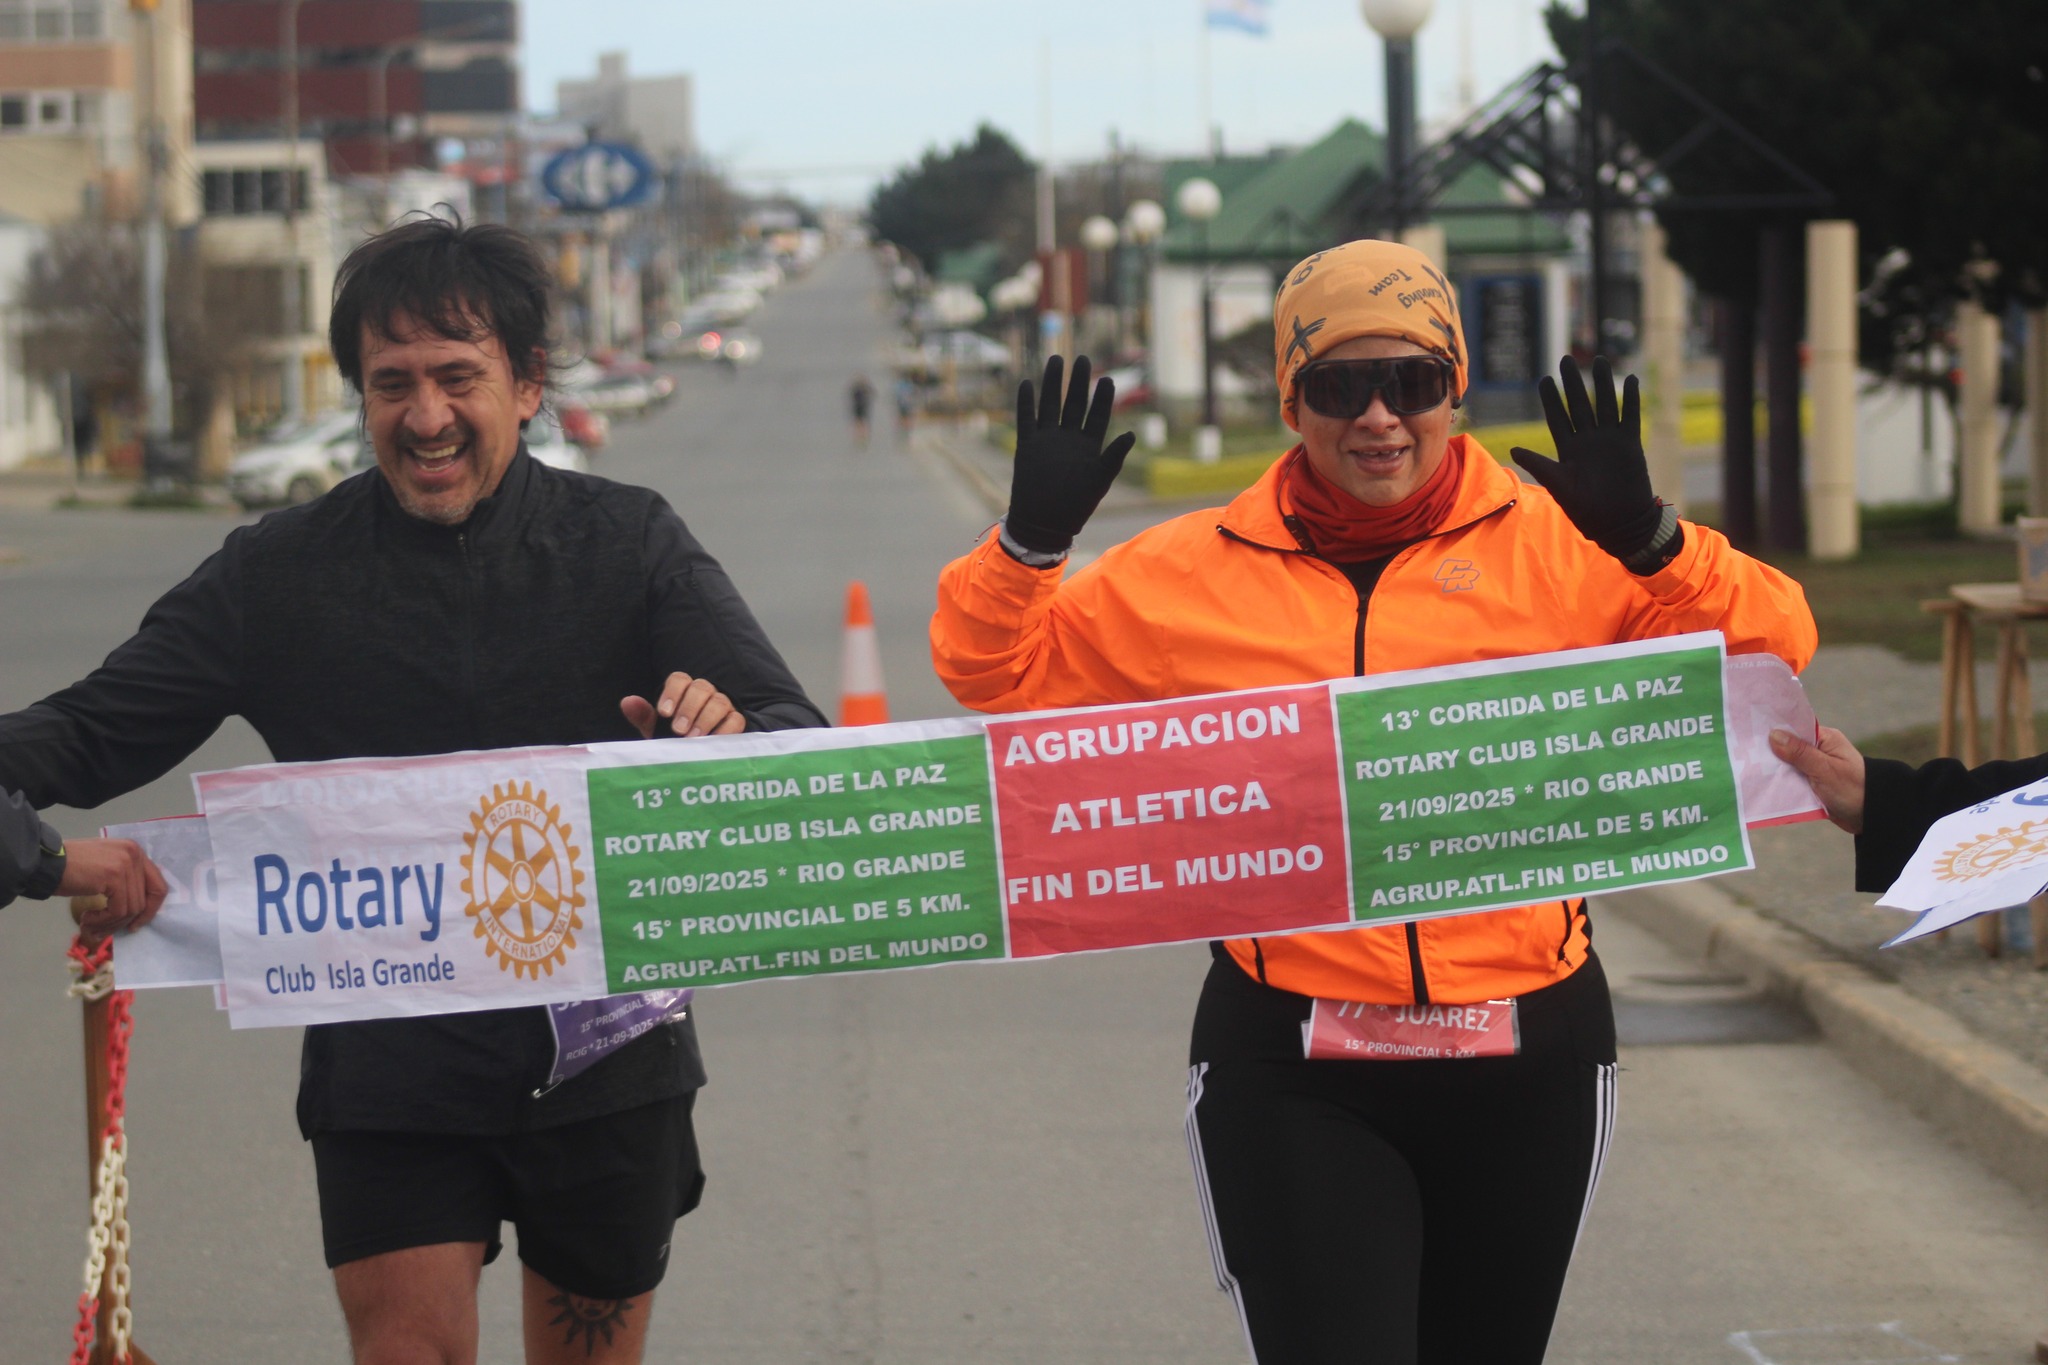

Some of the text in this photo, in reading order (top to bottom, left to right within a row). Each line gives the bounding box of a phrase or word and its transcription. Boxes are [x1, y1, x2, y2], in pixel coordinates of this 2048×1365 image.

[1368, 268, 1414, 297] Team
[1381, 675, 1683, 732] 13° CORRIDA DE LA PAZ
[1004, 703, 1300, 767] AGRUPACION
[1356, 714, 1714, 781] ROTARY CLUB ISLA GRANDE
[632, 763, 947, 810] 13° CORRIDA DE LA PAZ
[1051, 781, 1271, 834] ATLETICA
[1379, 786, 1516, 822] 21/09/2025
[1544, 777, 1590, 801] RIO
[1597, 760, 1704, 793] GRANDE
[489, 802, 541, 828] ROTARY
[604, 804, 982, 856] ROTARY CLUB ISLA GRANDE
[1382, 805, 1709, 864] 15° PROVINCIAL DE 5 KM.
[253, 853, 445, 942] Rotary
[628, 868, 769, 899] 21/09/2025
[798, 862, 845, 884] RIO
[853, 850, 966, 879] GRANDE
[1008, 844, 1324, 905] FIN DEL MUNDO
[1370, 845, 1729, 908] AGRUP.ATL.FIN DEL MUNDO
[484, 909, 571, 960] INTERNATIONAL
[632, 893, 971, 941] 15° PROVINCIAL DE 5 KM.
[266, 953, 456, 995] Club Isla Grande
[623, 933, 988, 984] AGRUP.ATL.FIN DEL MUNDO
[595, 999, 644, 1027] PROVINCIAL
[596, 1018, 654, 1050] 21-09-2025
[1394, 1003, 1491, 1033] JUAREZ
[1367, 1040, 1440, 1058] PROVINCIAL
[1444, 1048, 1453, 1058] 5
